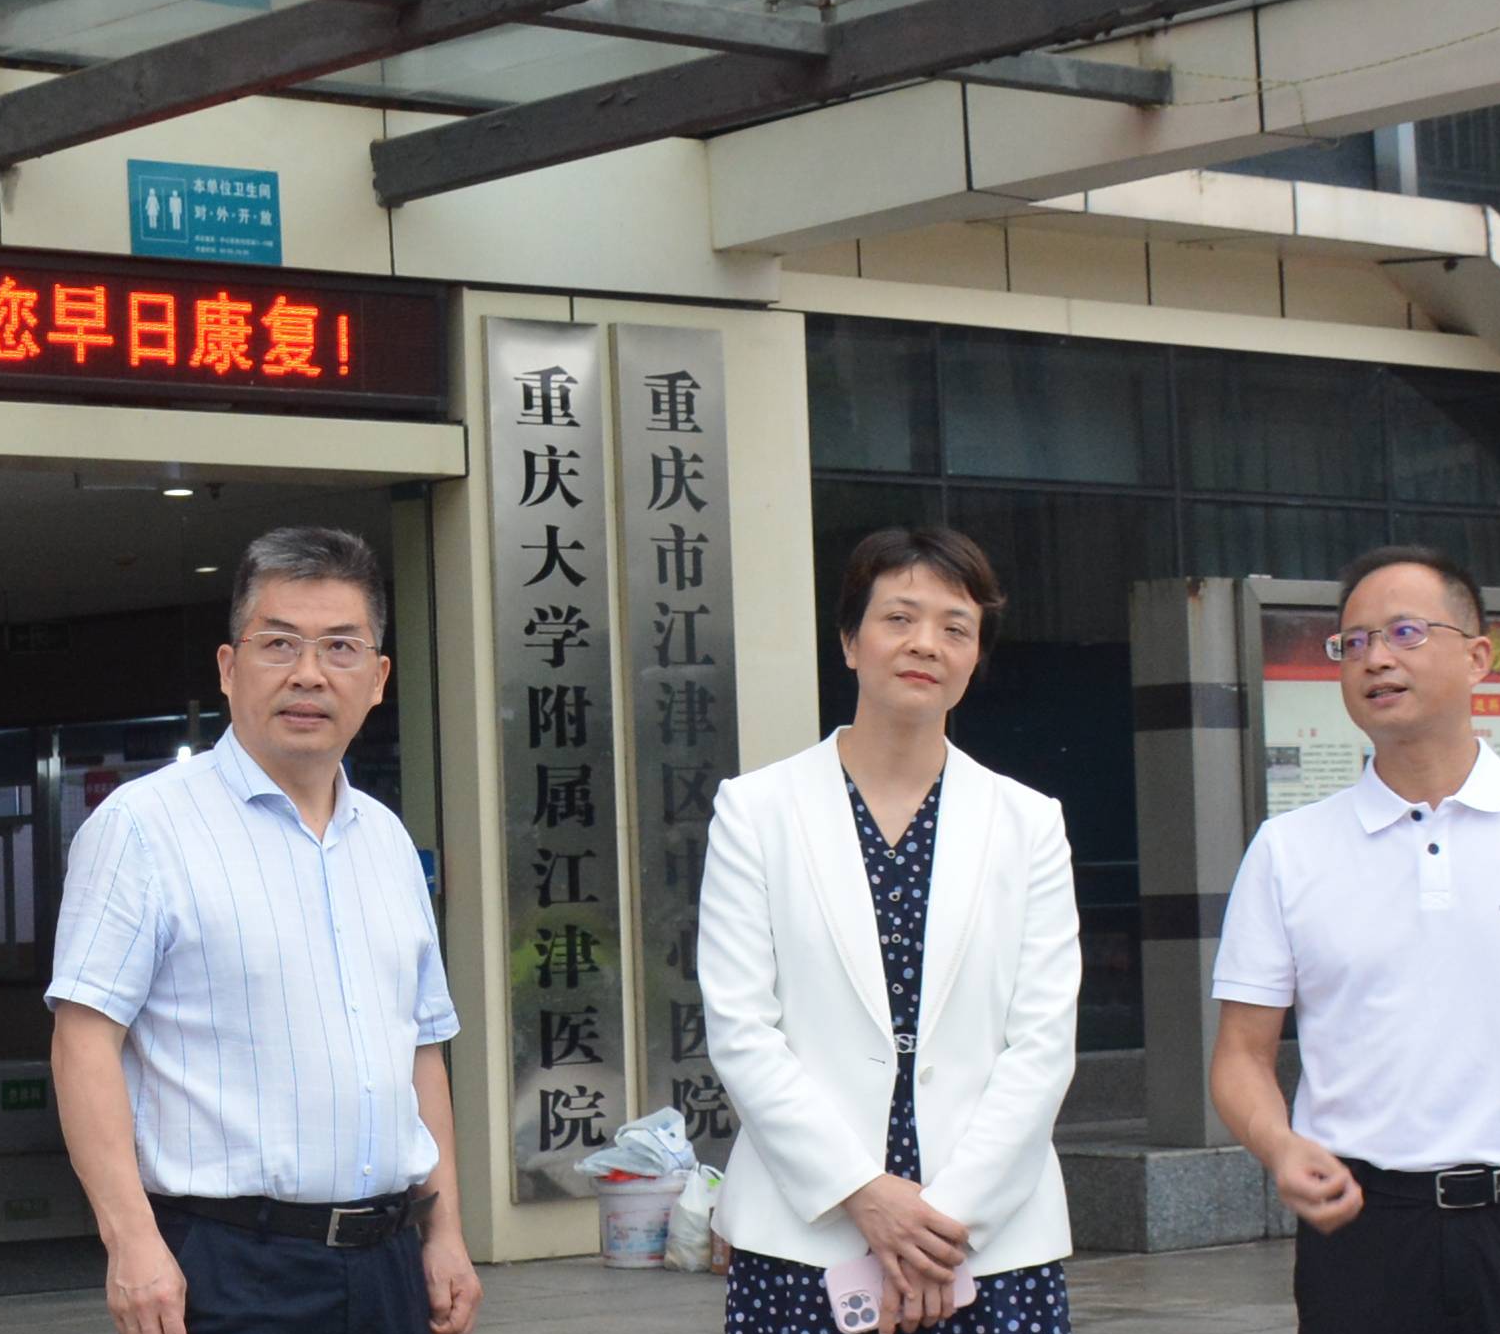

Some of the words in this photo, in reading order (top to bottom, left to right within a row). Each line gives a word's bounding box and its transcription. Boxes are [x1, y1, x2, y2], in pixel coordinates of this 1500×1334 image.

[193, 179, 272, 200] 本单位卫生间
[513, 365, 608, 1152] 重庆大学附属江津医院
